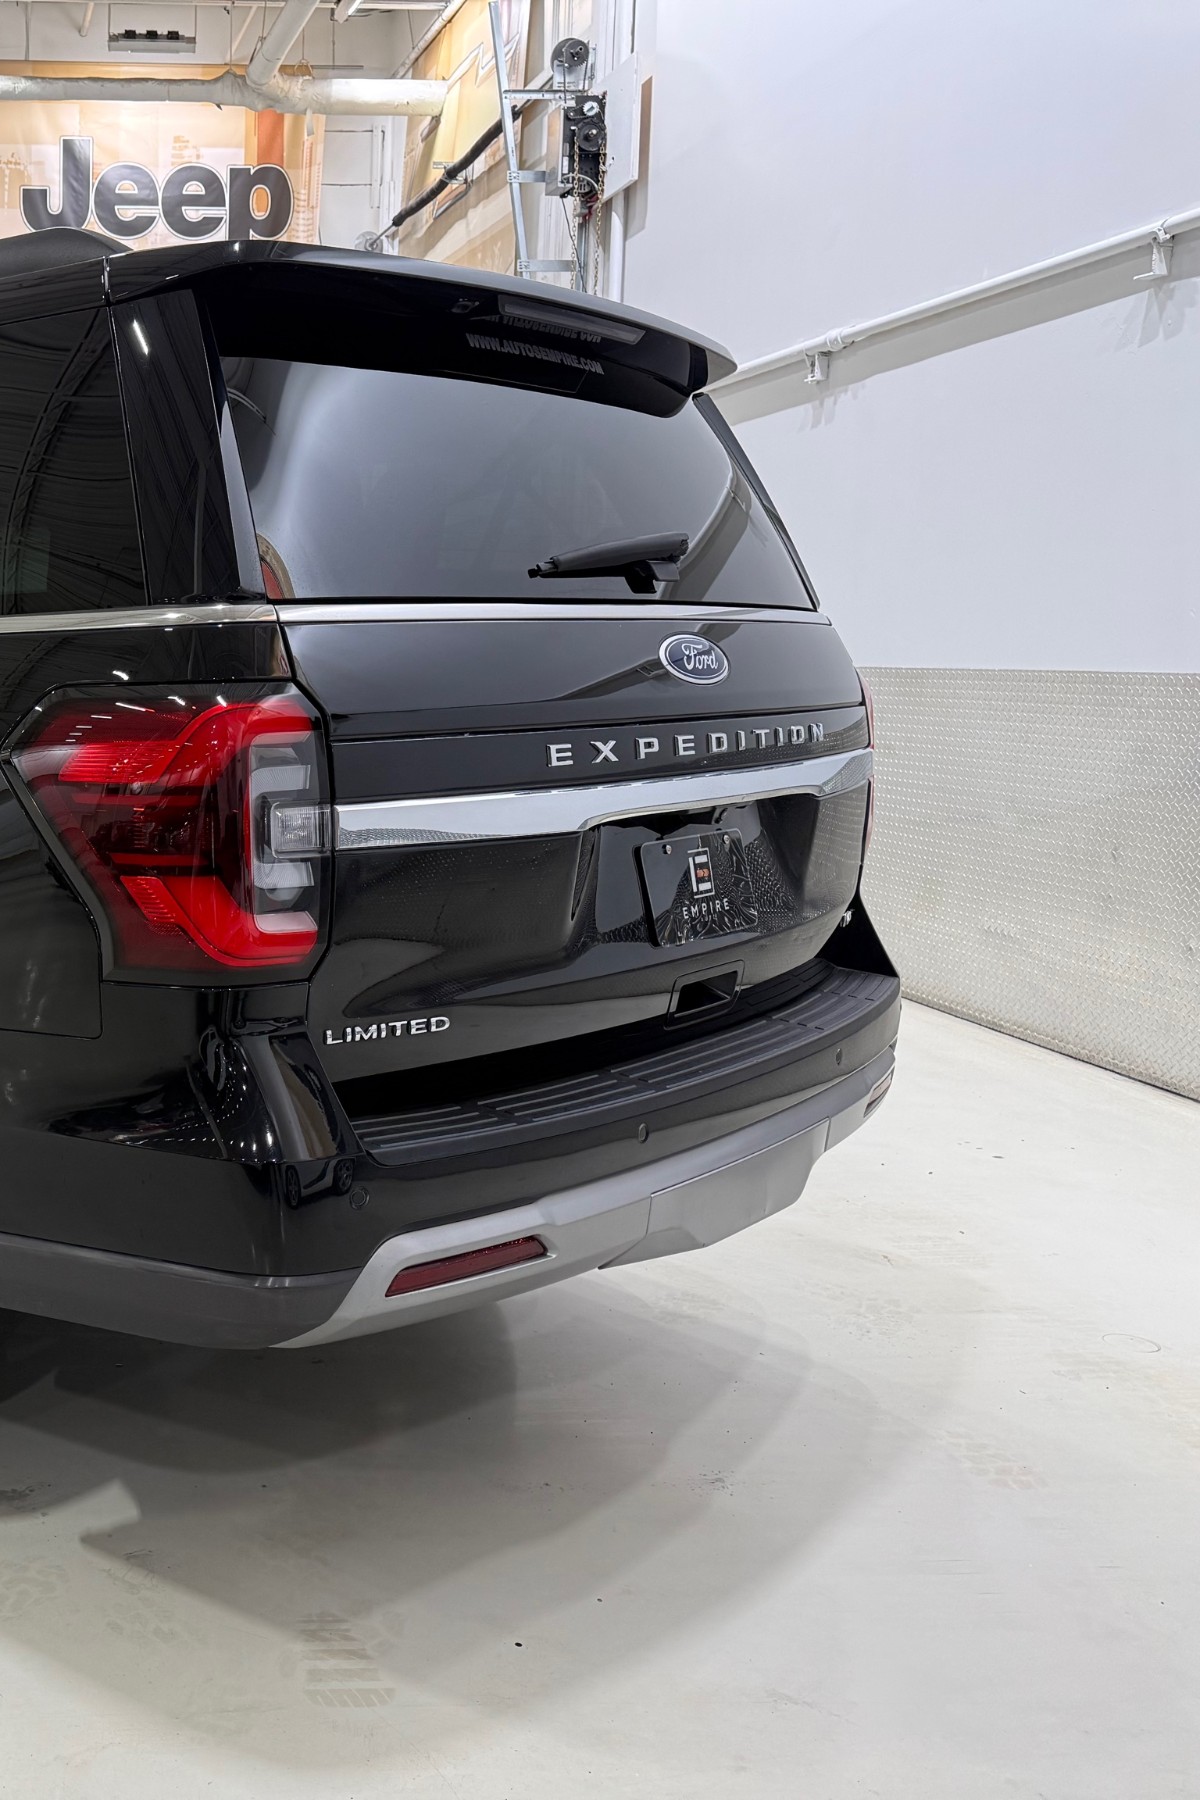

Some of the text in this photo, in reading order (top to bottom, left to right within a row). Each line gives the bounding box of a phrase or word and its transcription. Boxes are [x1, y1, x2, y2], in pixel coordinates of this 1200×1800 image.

[19, 136, 294, 240] Jeep
[464, 332, 605, 375] WWW.AUTOSEMPIRE.COM
[681, 643, 719, 670] Ford
[546, 722, 825, 767] EXPEDITION
[682, 898, 730, 919] EMPIRE
[324, 1016, 450, 1045] LIMITED
